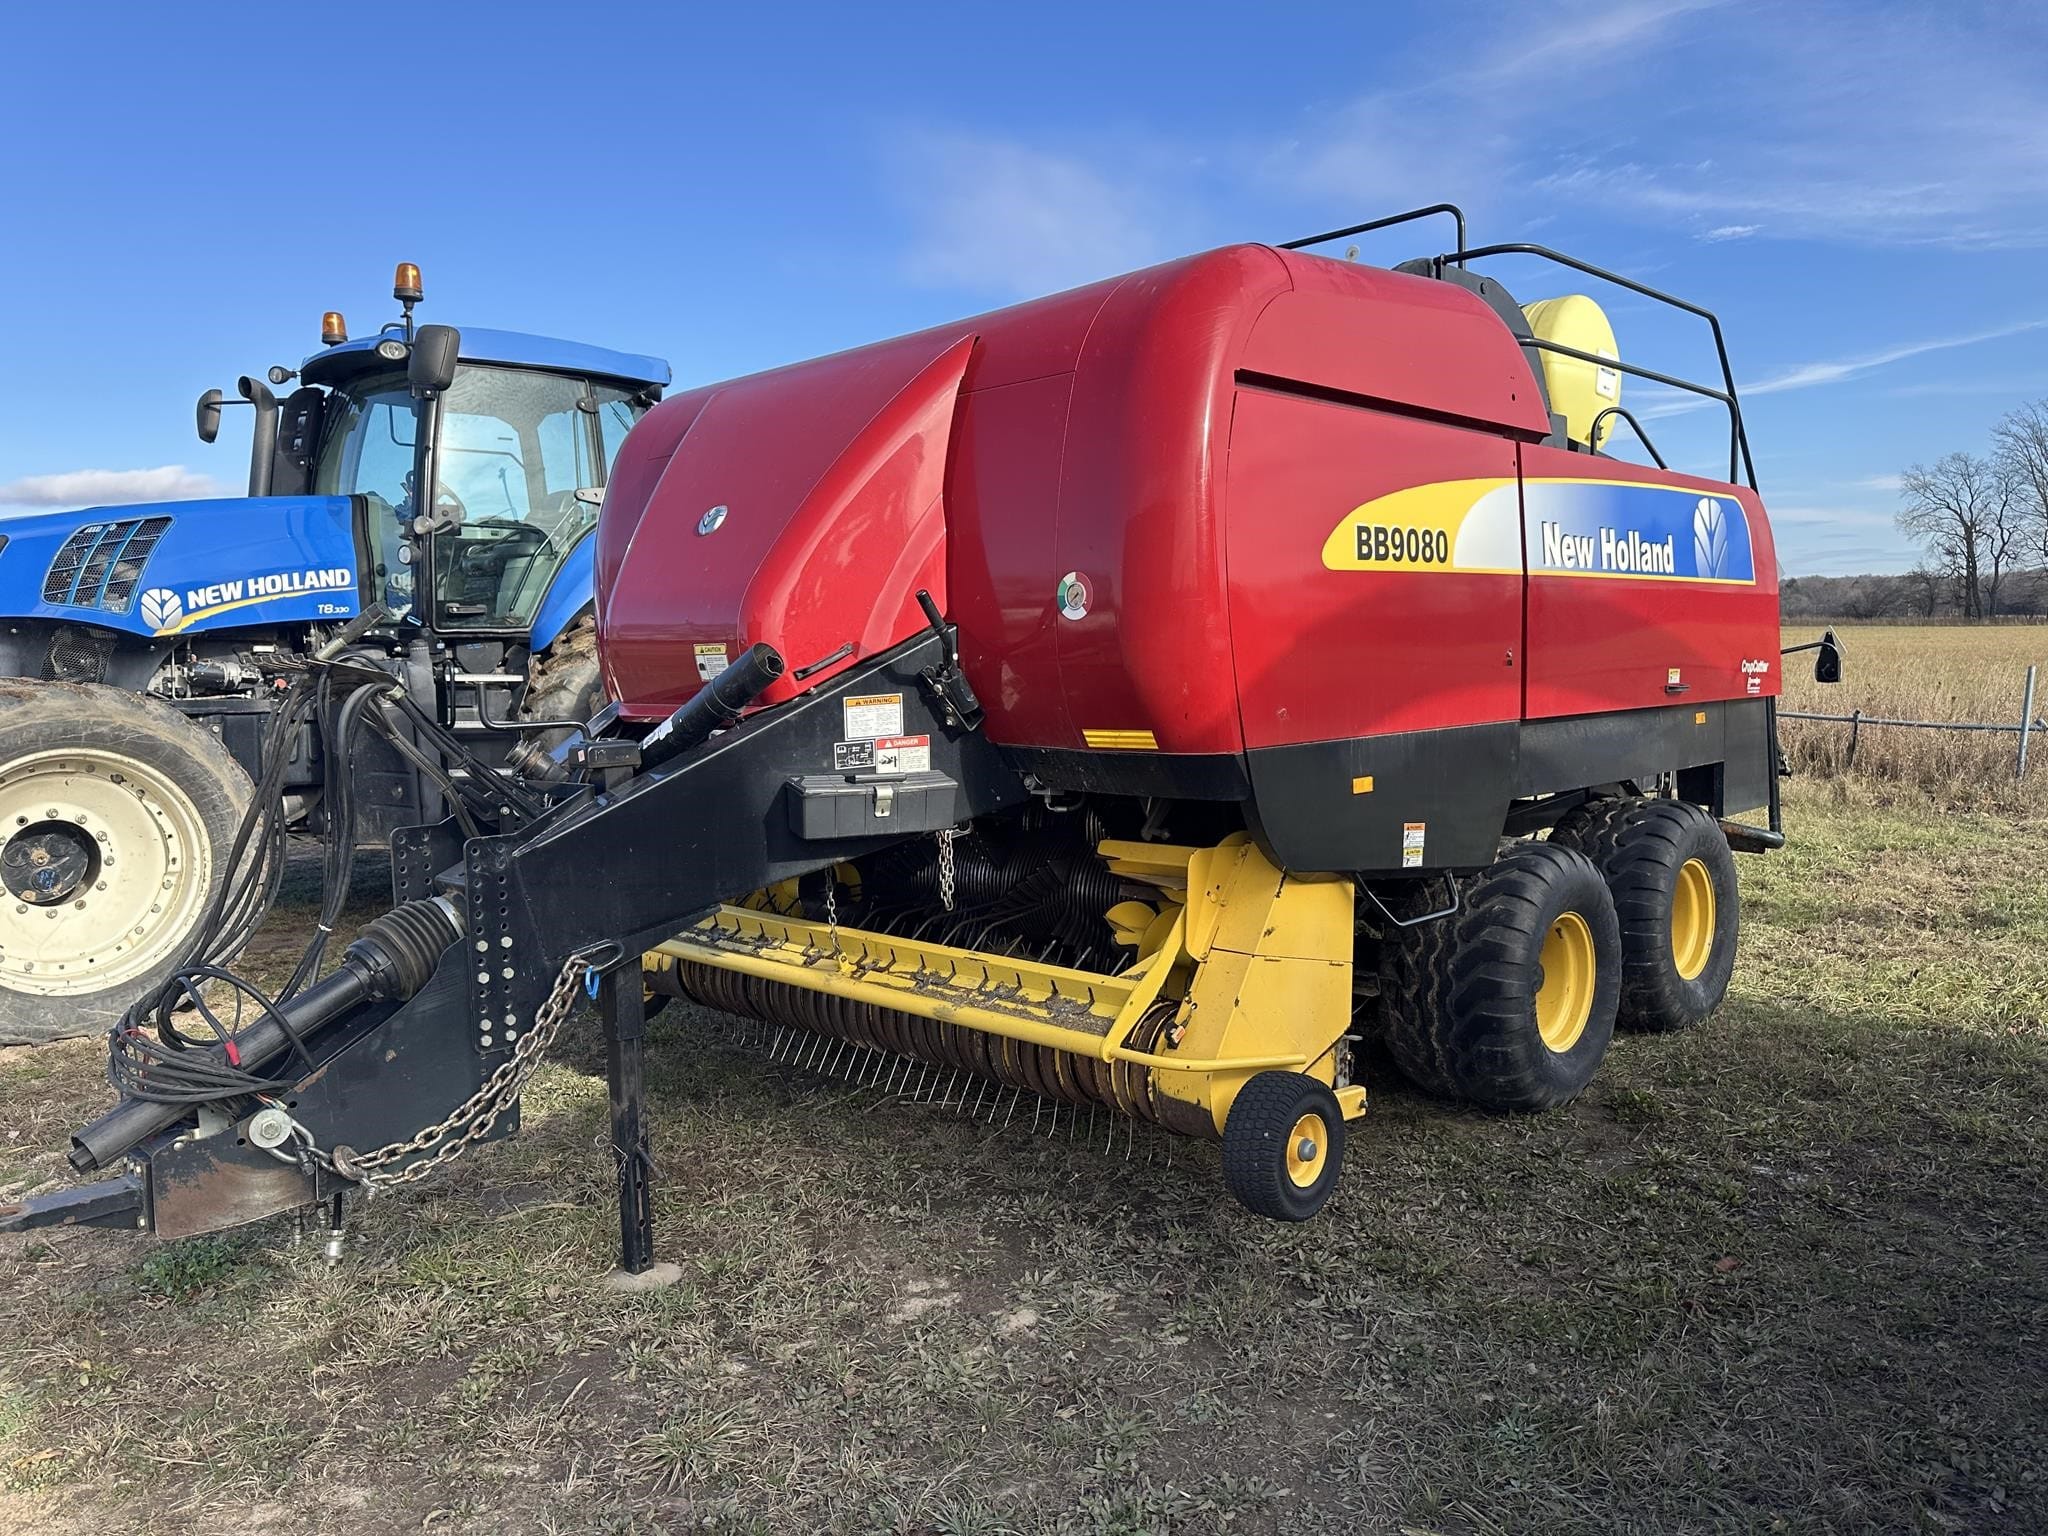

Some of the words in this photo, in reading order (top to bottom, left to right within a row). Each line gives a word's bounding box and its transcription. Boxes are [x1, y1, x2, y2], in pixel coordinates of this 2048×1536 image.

[1356, 525, 1449, 564] BB9080
[1541, 521, 1595, 569] New
[1599, 527, 1675, 574] Holland
[187, 581, 243, 609] NEW
[248, 568, 351, 597] HOLLAND
